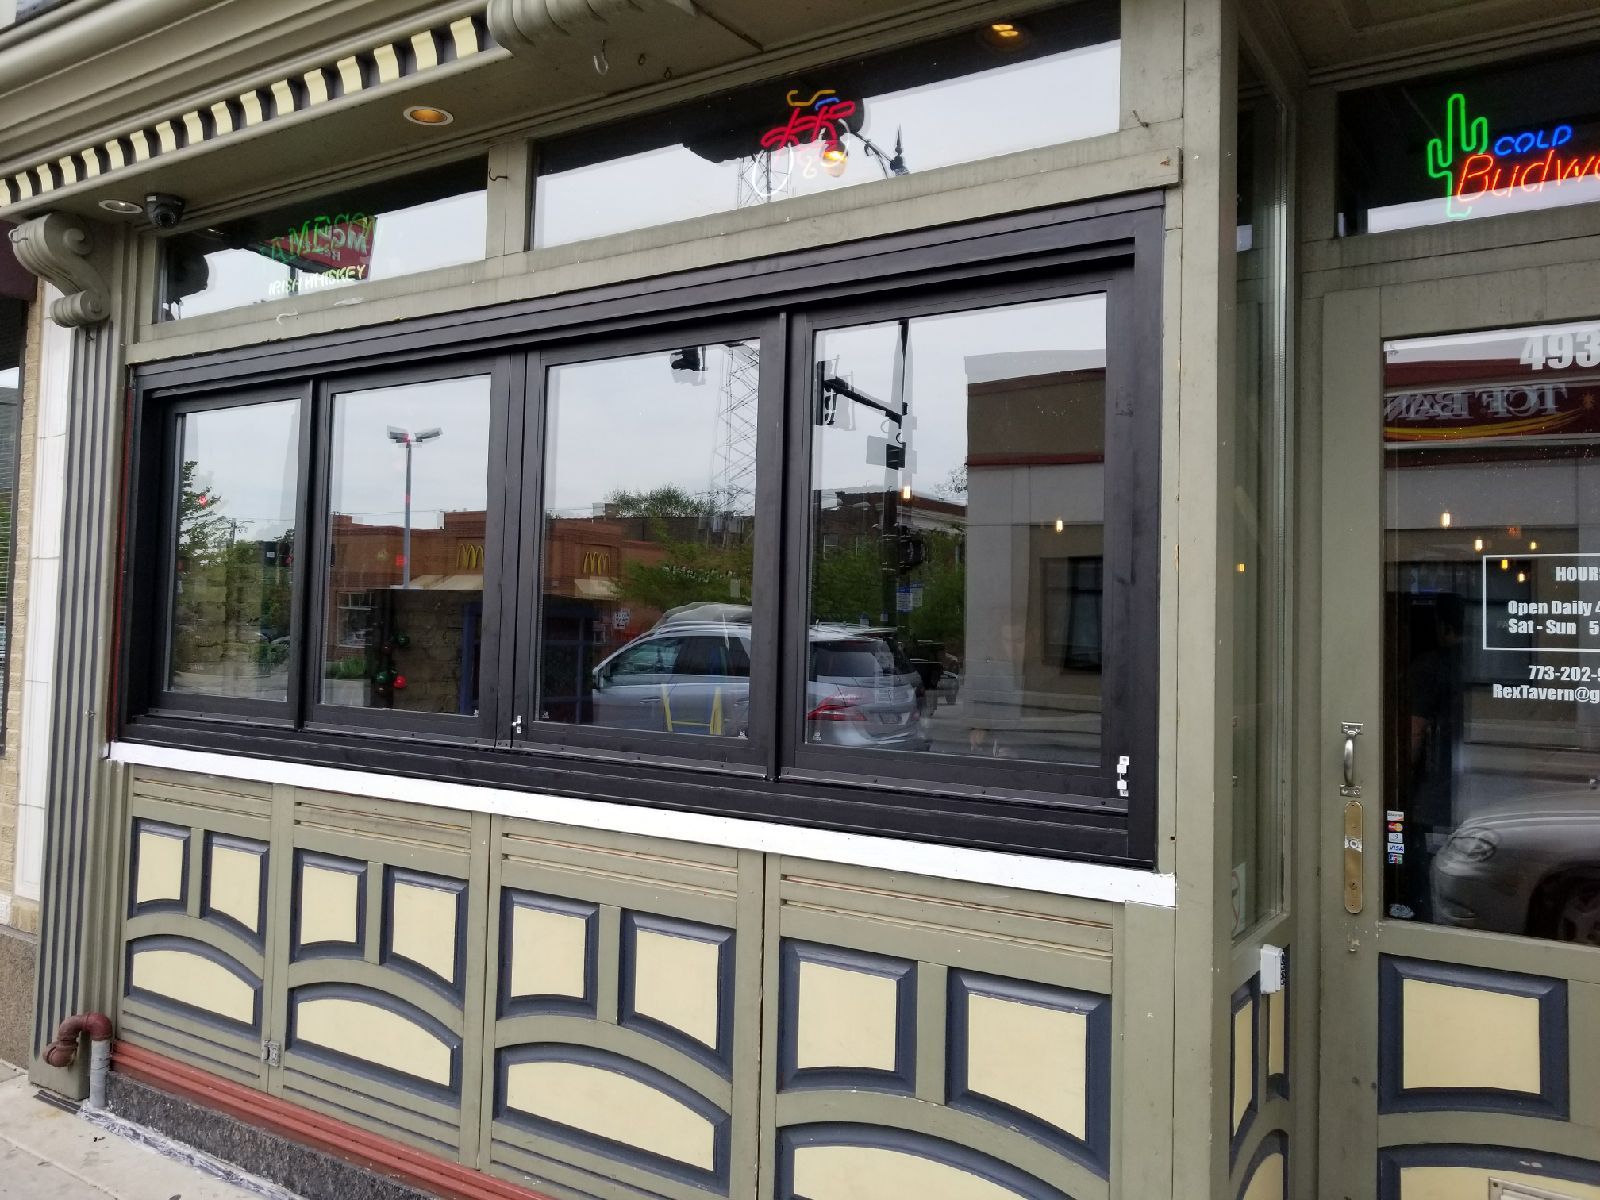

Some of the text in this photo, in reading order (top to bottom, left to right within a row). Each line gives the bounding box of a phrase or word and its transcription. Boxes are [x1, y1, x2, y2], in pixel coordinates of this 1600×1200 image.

[1493, 124, 1574, 157] COLD
[1519, 331, 1600, 371] 493
[1555, 566, 1600, 581] HOUR
[1508, 600, 1548, 616] Open
[1551, 600, 1592, 616] Daily
[1508, 618, 1534, 634] Sat
[1545, 619, 1577, 635] Sun
[1589, 620, 1600, 635] 5
[1528, 665, 1600, 682] 773-202-
